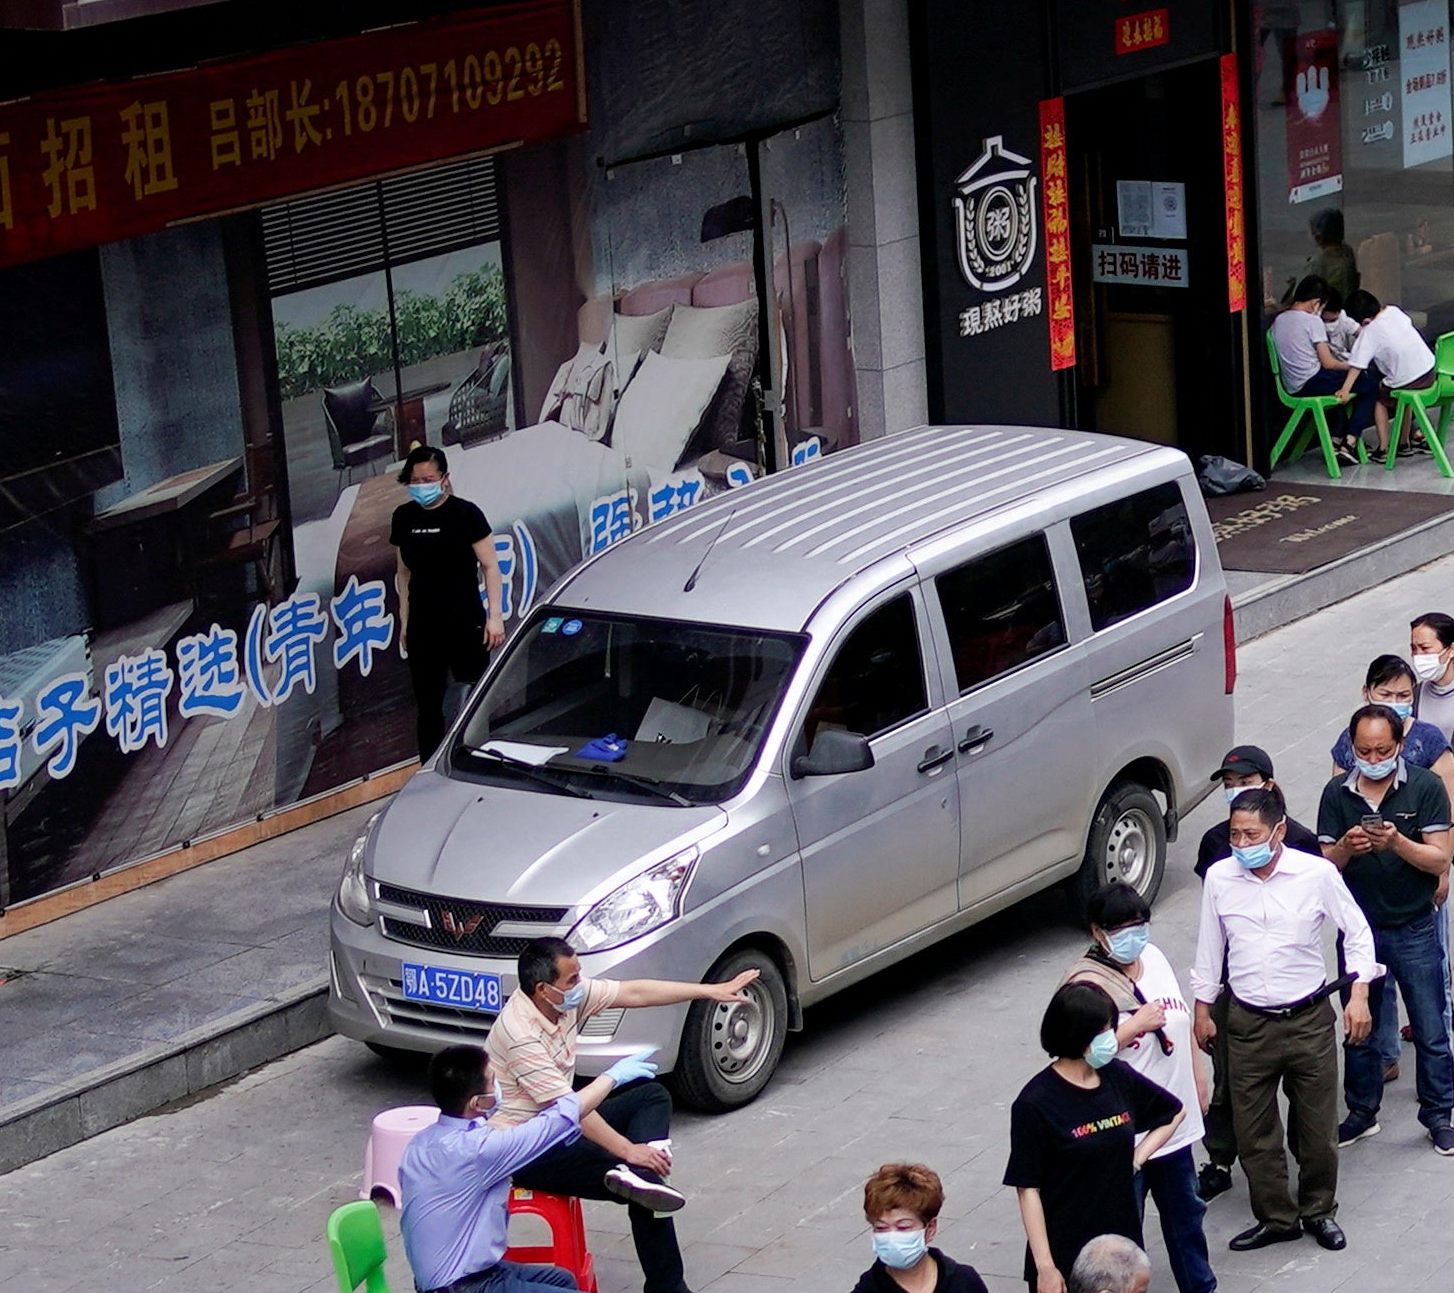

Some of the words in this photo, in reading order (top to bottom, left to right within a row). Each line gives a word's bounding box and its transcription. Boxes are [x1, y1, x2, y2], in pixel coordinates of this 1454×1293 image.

[986, 207, 1011, 242] 粥
[1098, 250, 1182, 281] 扫码请进
